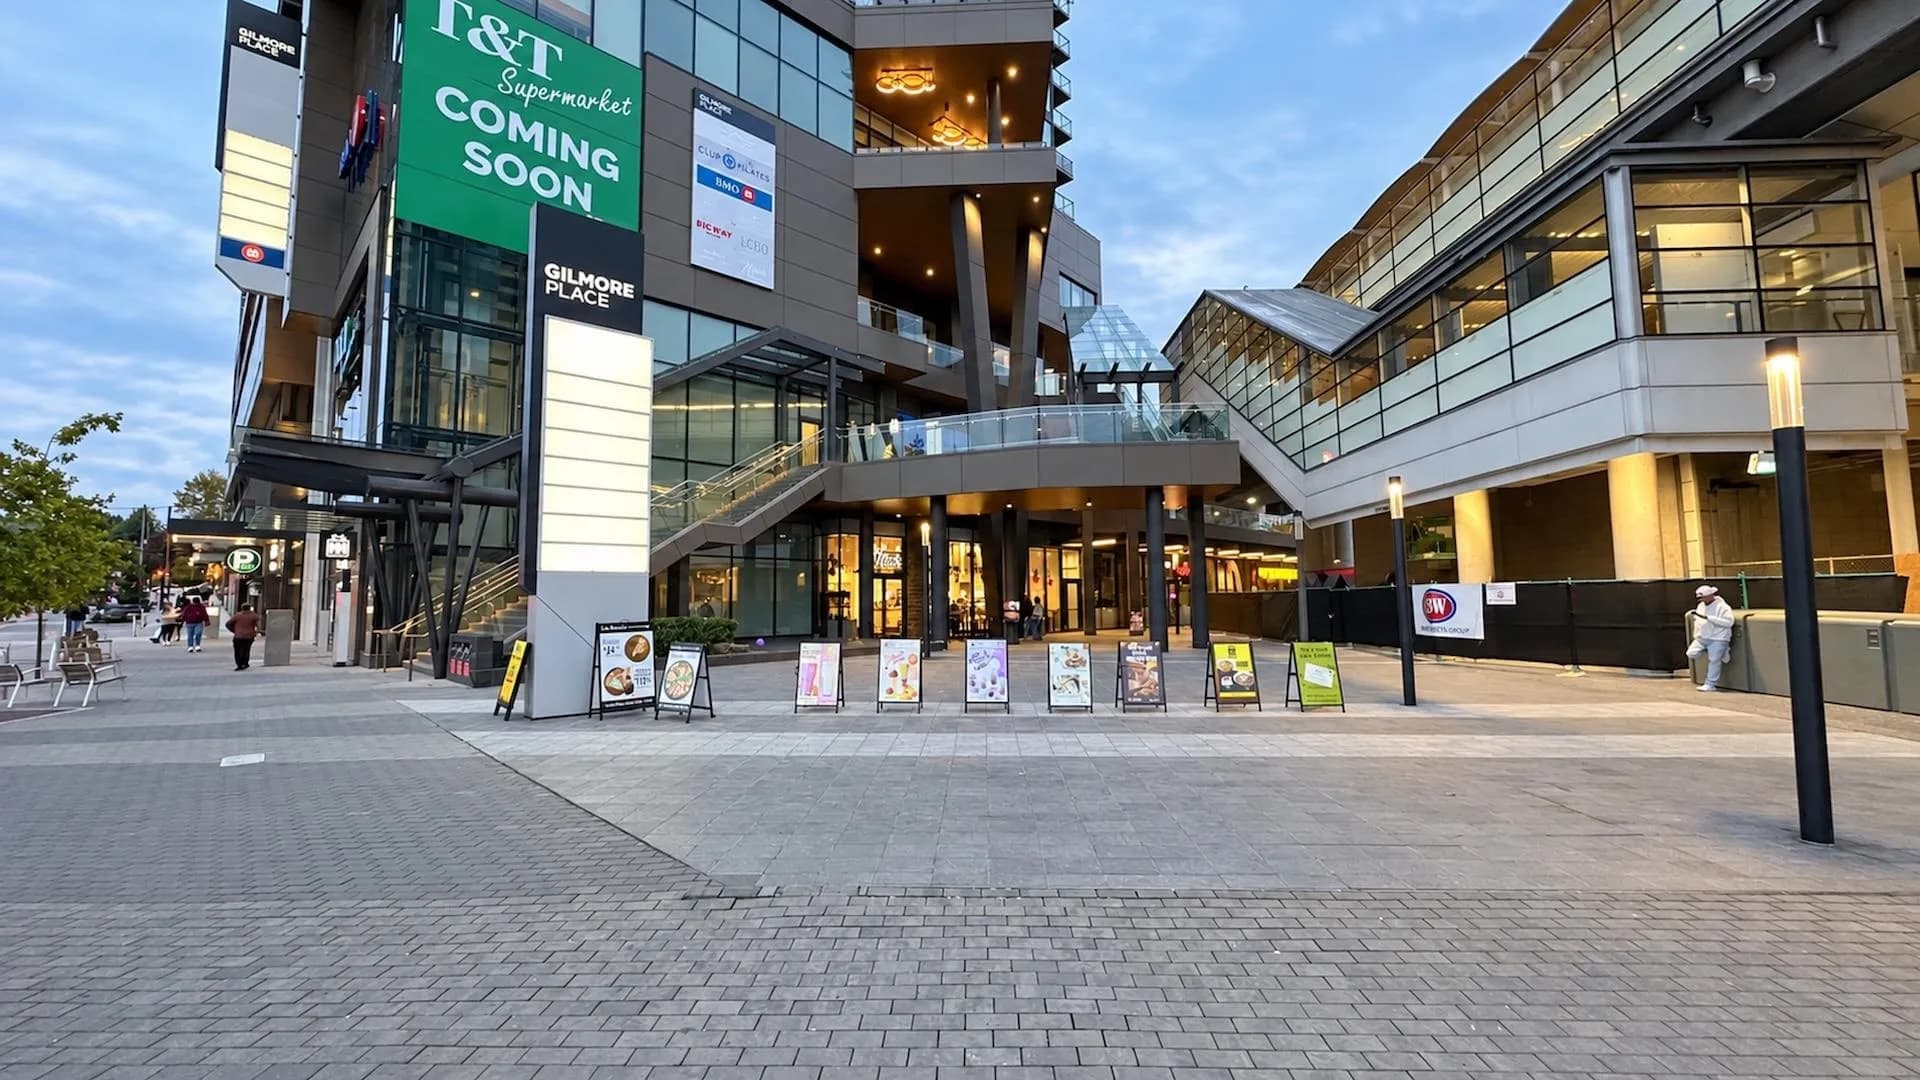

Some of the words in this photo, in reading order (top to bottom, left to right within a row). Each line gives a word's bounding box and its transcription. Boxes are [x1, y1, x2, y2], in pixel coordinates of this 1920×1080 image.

[238, 27, 296, 56] GILMORE
[238, 35, 279, 57] PLACE
[431, 0, 563, 81] T&T
[497, 66, 633, 116] Supermarket
[435, 86, 620, 182] COMING
[462, 141, 593, 213] SOON
[715, 176, 740, 194] BMO
[544, 263, 635, 299] GILMORE
[545, 279, 610, 308] PLACE
